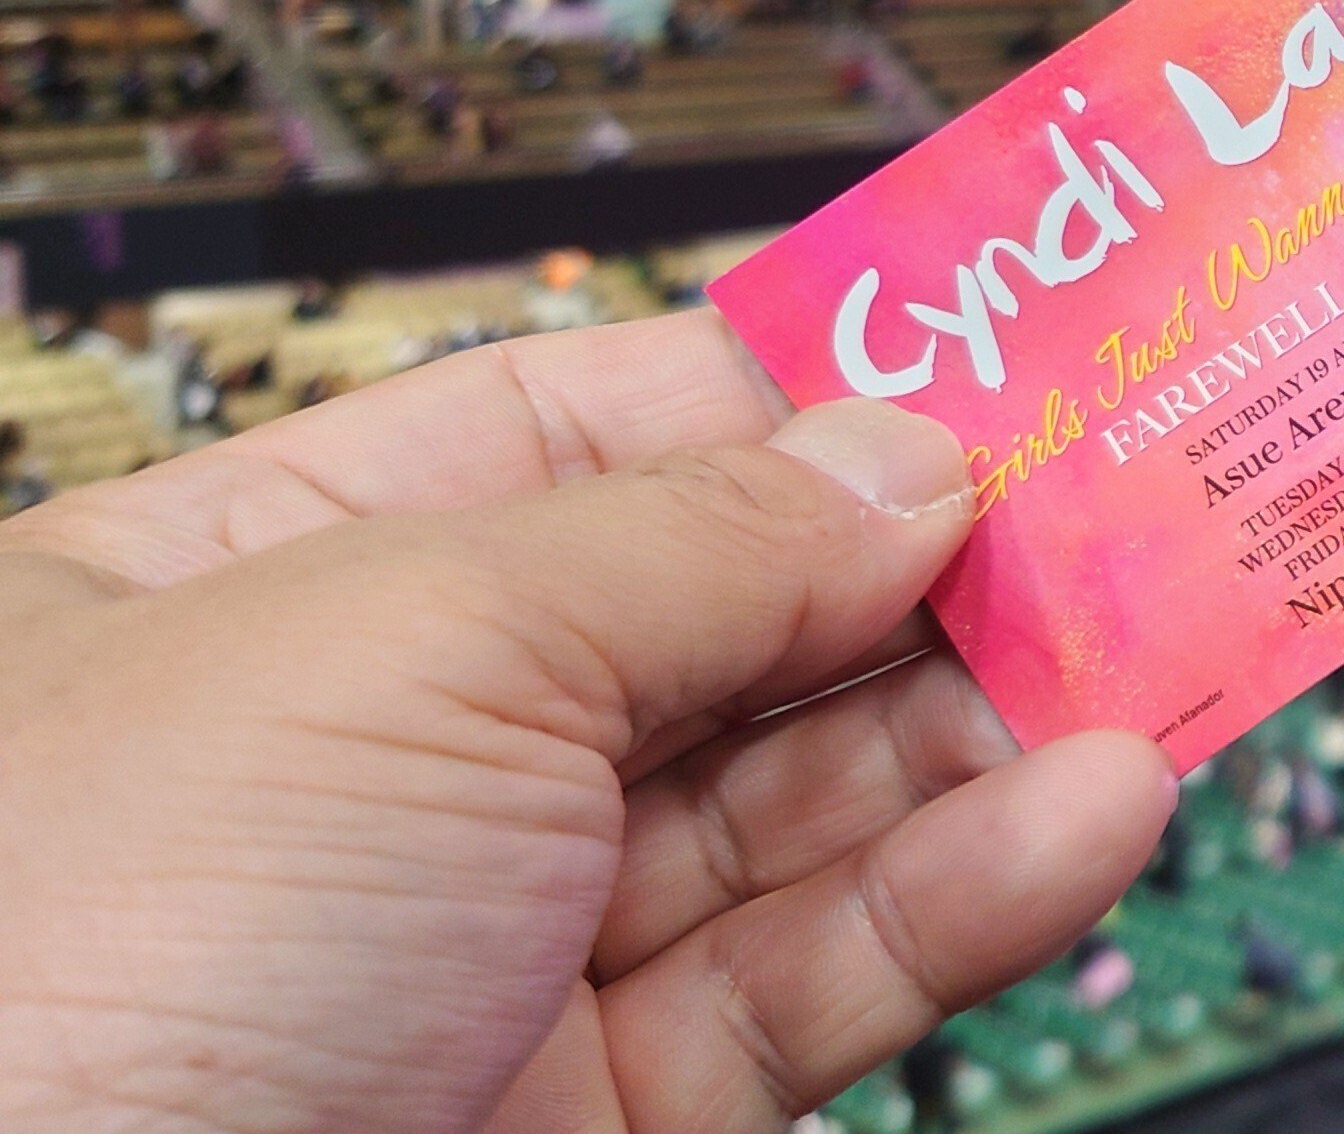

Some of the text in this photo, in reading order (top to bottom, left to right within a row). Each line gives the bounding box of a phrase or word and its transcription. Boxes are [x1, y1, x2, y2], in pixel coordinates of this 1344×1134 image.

[834, 88, 1165, 398] Cyndi
[967, 389, 1088, 521] Girls
[1095, 286, 1196, 410] Just
[1185, 372, 1304, 465] SATURDAY
[1306, 358, 1330, 384] 19
[1200, 439, 1283, 509] Asue
[1153, 688, 1225, 743] uven Afanador
